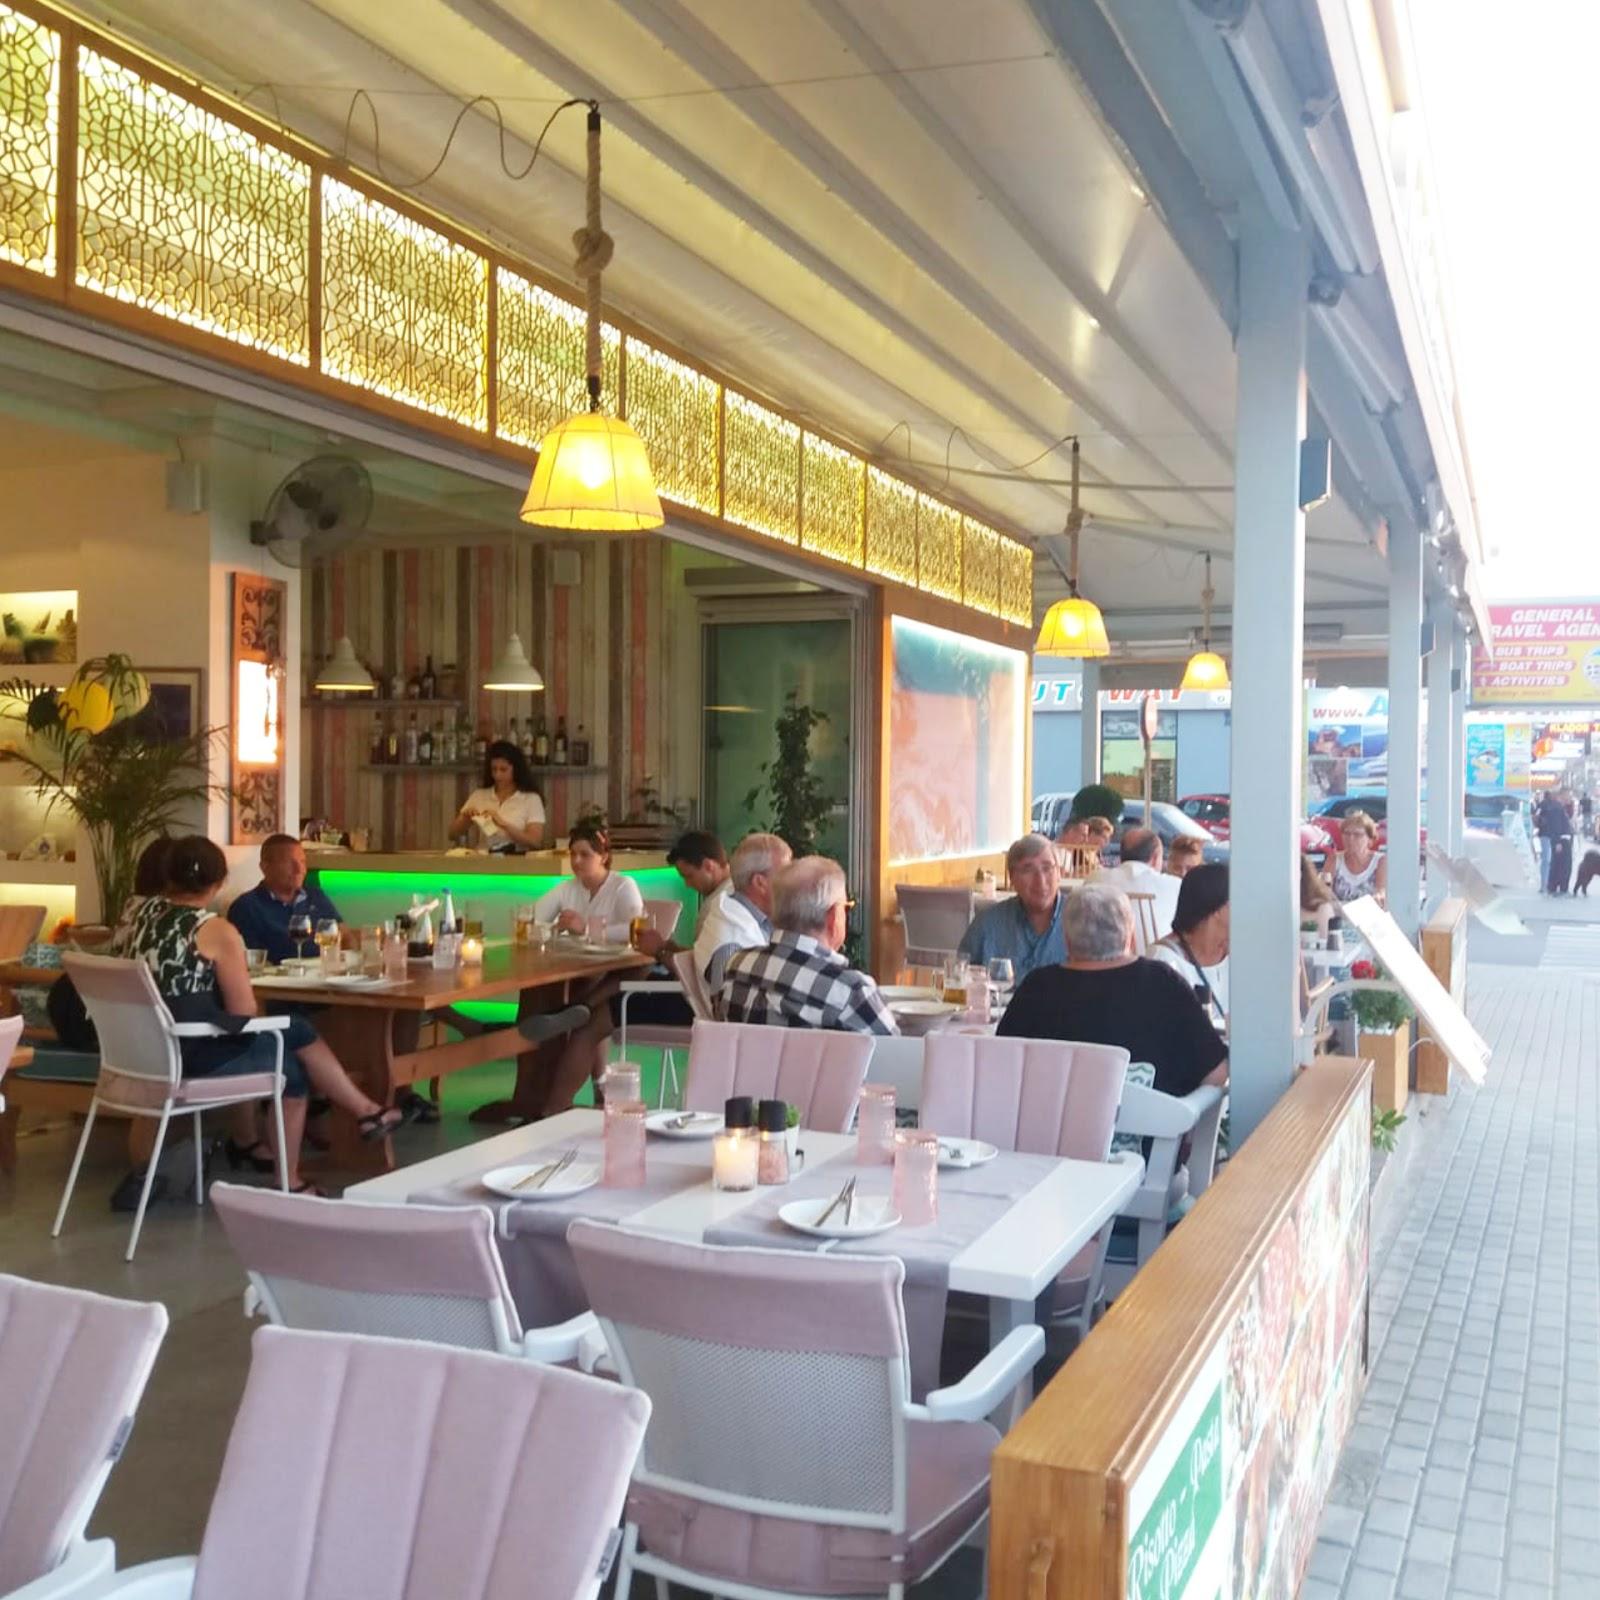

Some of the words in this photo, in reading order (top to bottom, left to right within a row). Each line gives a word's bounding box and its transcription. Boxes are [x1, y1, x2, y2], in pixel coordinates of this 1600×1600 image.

[1511, 608, 1595, 623] GENERAL
[1490, 623, 1546, 638] RAVEL
[1553, 622, 1600, 638] AGEN
[1495, 646, 1522, 657] BUS
[1526, 645, 1565, 656] TRIPS
[1499, 660, 1533, 671] BOAT
[1535, 660, 1573, 671] TRIPS
[1492, 675, 1566, 686] ACTIVITIES
[1312, 694, 1389, 719] www.A
